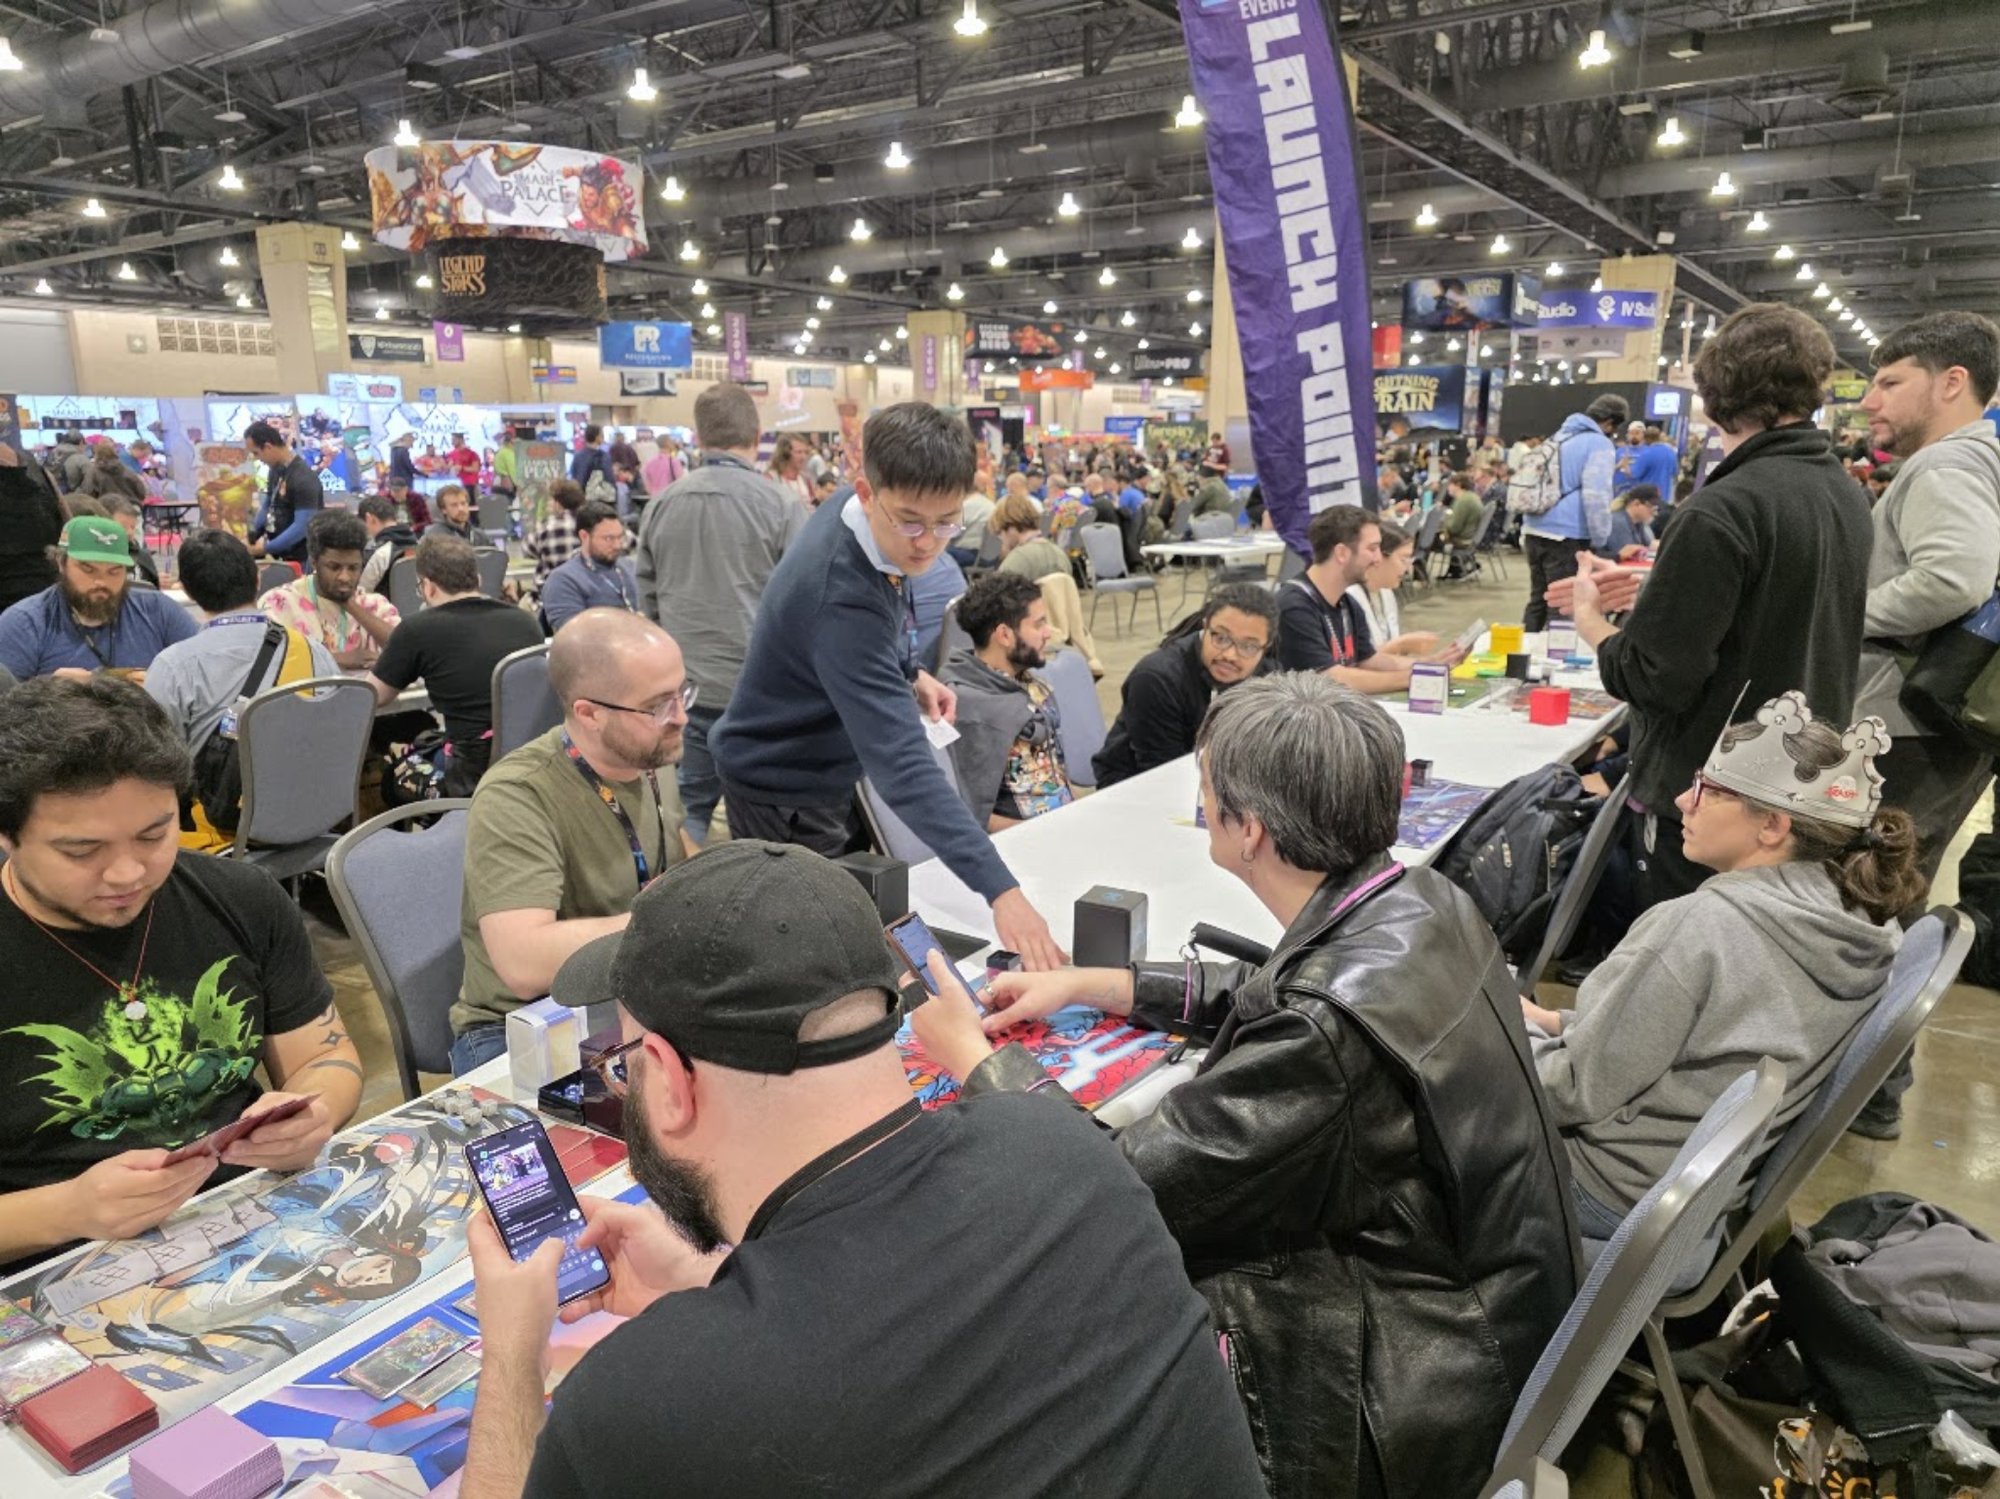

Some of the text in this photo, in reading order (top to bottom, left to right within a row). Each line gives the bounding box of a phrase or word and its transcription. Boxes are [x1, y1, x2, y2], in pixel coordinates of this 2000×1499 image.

[1247, 13, 1338, 313] LAUNCH
[500, 180, 568, 203] PALACE
[439, 255, 486, 275] LEGEND
[441, 272, 486, 295] STORY
[1633, 301, 1656, 318] Stud
[979, 331, 1009, 340] YOUR
[979, 340, 1010, 351] HERO
[1374, 374, 1440, 389] GHTNING
[1297, 321, 1363, 514] POINT
